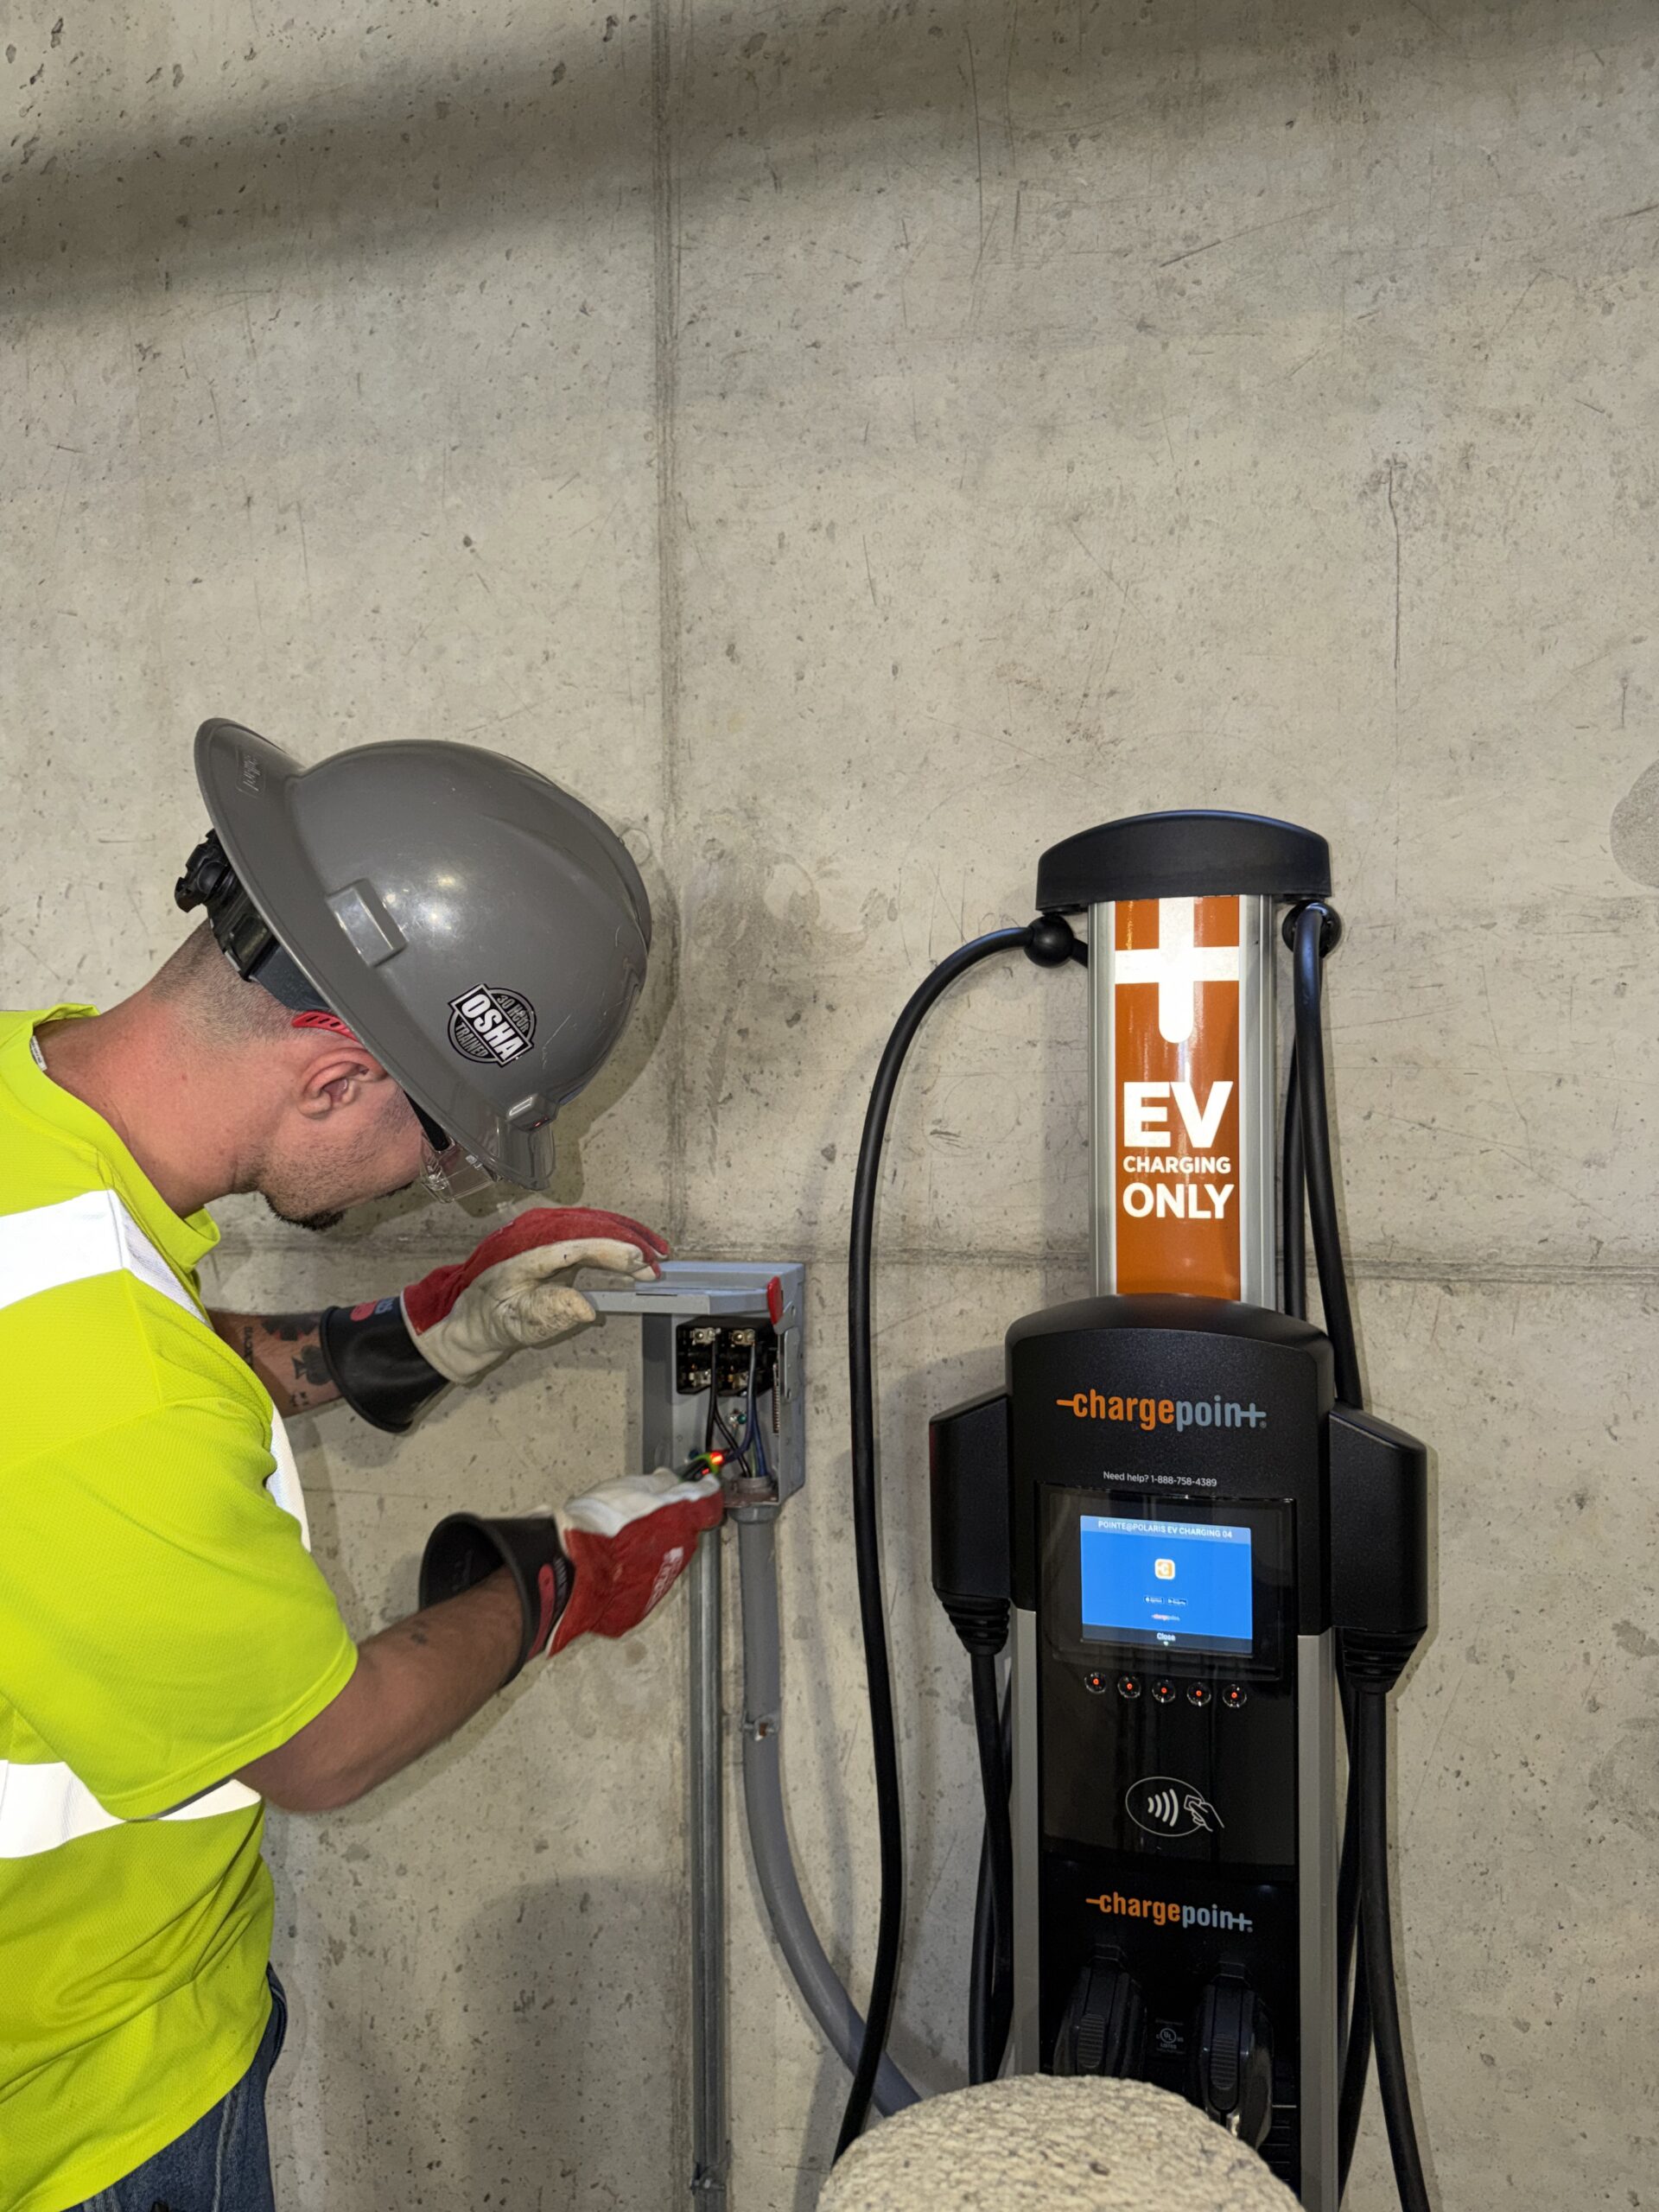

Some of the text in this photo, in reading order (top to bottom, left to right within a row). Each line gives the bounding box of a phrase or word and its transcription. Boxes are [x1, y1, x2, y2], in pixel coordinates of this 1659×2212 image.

[497, 995, 516, 1010] 30
[461, 994, 524, 1061] OSHA
[455, 1021, 489, 1057] TRAINED
[1123, 1081, 1234, 1148] EV
[1122, 1155, 1231, 1174] CHARGING
[1122, 1182, 1235, 1219] ONLY
[1103, 1471, 1217, 1487] Need help? 1-888-758-4389
[1097, 1520, 1166, 1534] POINTE@POLARIS
[1179, 1528, 1221, 1537] CHARGING
[1156, 1632, 1176, 1642] Close
